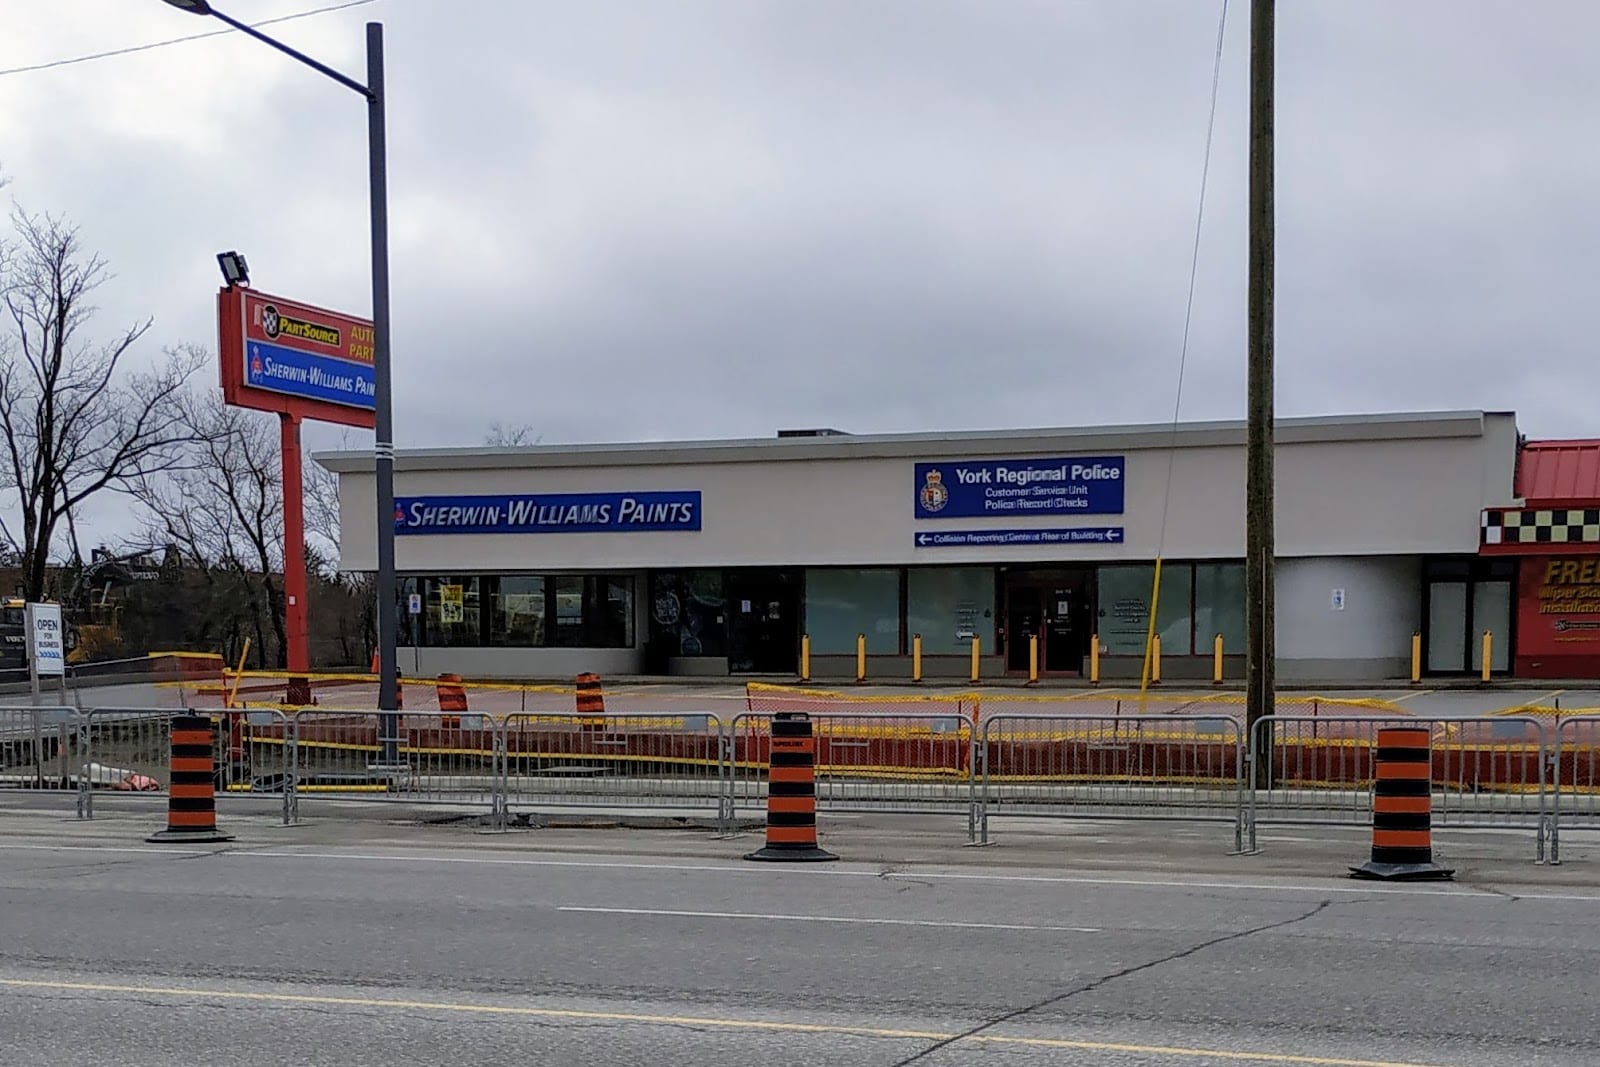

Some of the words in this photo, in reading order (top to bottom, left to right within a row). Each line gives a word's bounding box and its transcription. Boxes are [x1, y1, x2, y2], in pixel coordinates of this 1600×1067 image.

[349, 343, 375, 361] PART
[355, 376, 376, 397] PAIN
[956, 468, 992, 484] York
[996, 465, 1067, 486] Regional
[1071, 464, 1121, 481] Police
[985, 487, 1031, 498] Customer
[1068, 485, 1088, 495] Unit
[618, 498, 693, 524] PAINTS
[985, 499, 1016, 510] Police
[37, 619, 58, 631] OPEN
